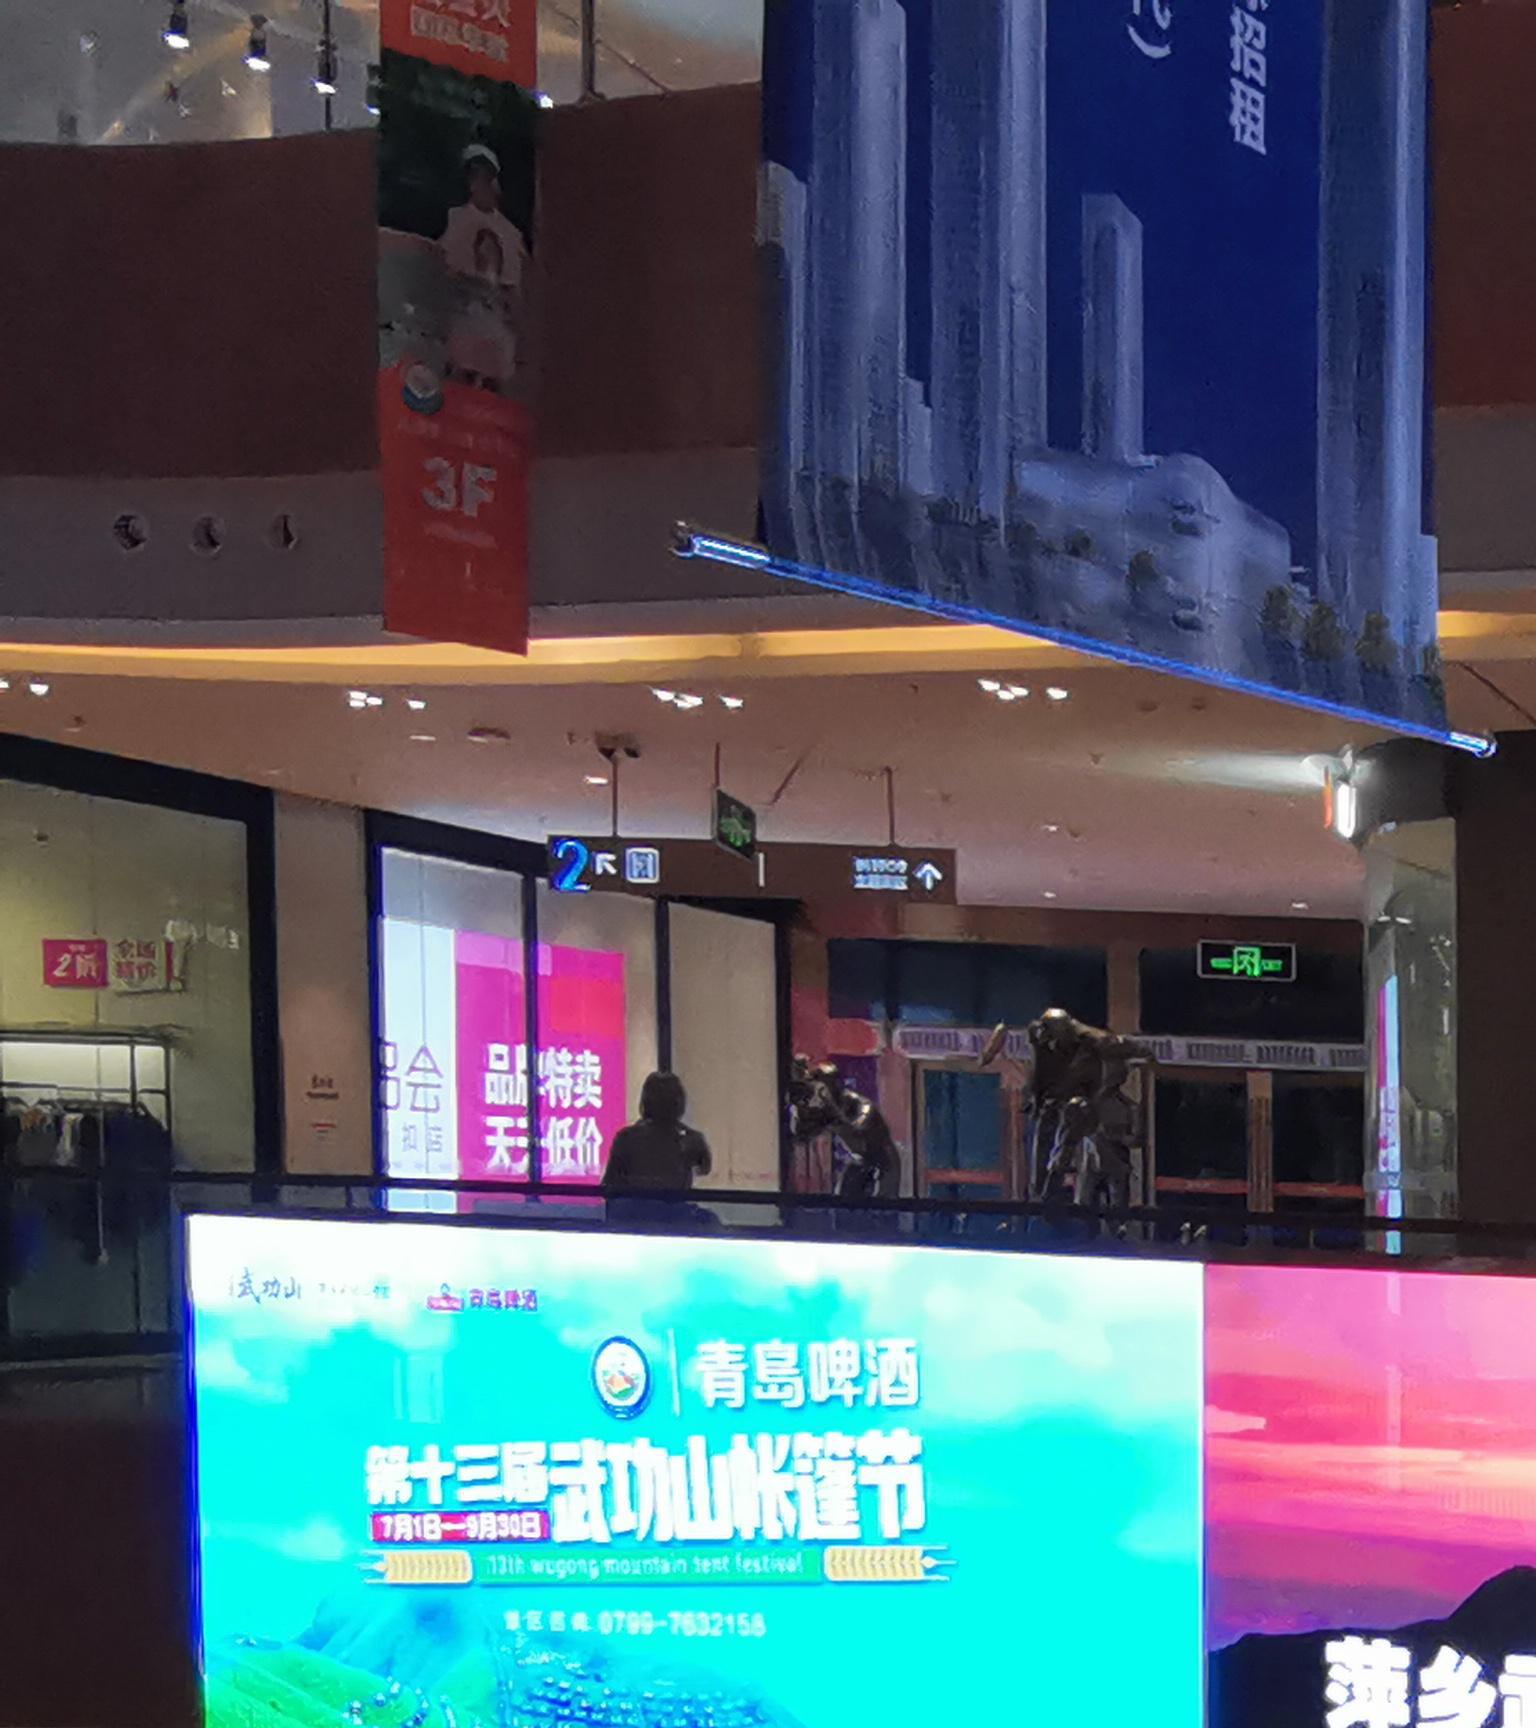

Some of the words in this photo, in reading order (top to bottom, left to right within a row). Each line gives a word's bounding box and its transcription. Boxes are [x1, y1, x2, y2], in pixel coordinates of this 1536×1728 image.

[421, 456, 498, 517] 3F
[552, 838, 593, 892] 2
[696, 1338, 919, 1409] 青岛啤酒
[366, 1442, 547, 1507] 第十三届
[549, 1428, 927, 1543] 武功山帐篷节
